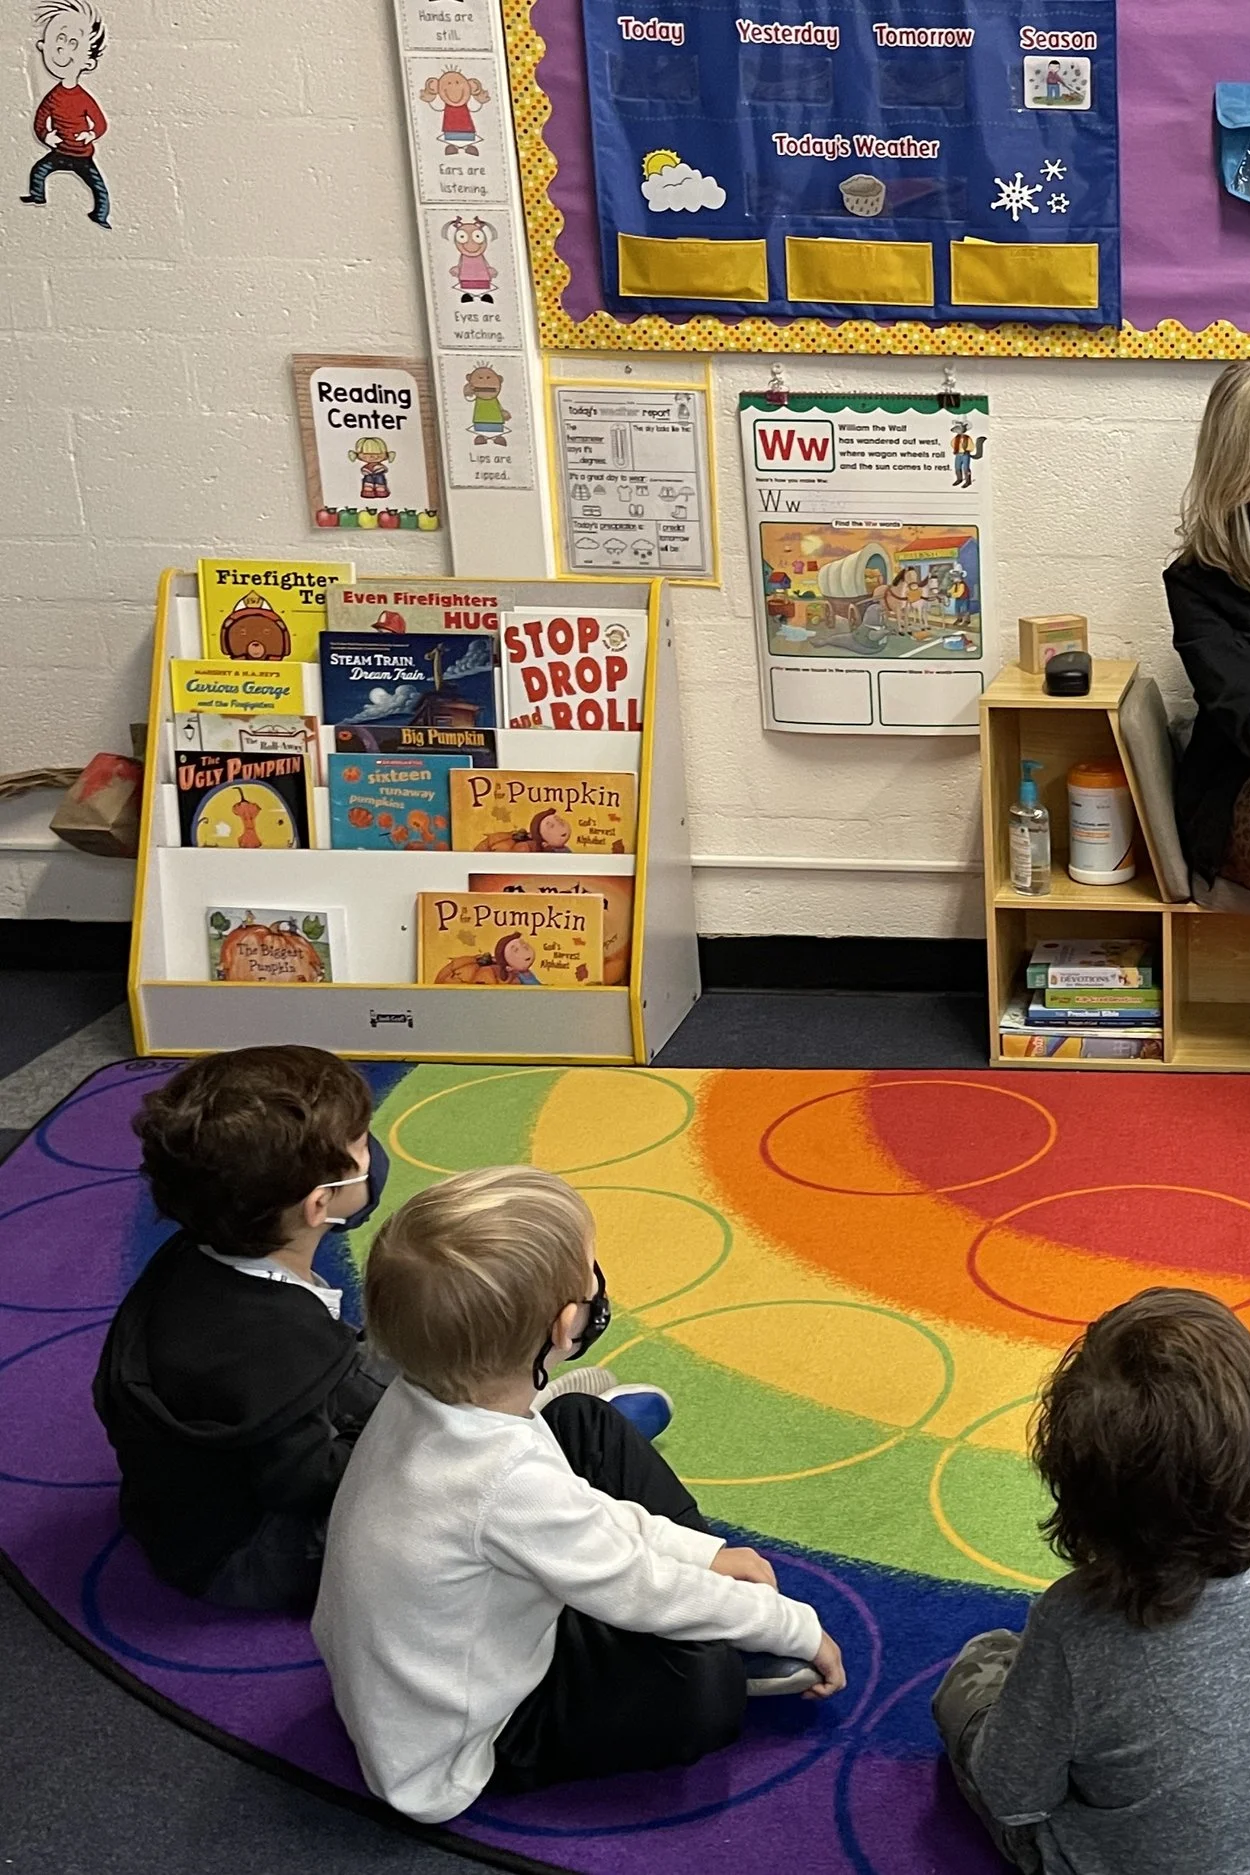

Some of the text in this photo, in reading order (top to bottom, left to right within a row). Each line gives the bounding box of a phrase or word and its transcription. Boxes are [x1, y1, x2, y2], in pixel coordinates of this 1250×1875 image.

[418, 10, 474, 22] Hands are
[618, 16, 1097, 51] Today Yesterday Tomorrow Season
[772, 132, 939, 160] Today's Weather
[439, 163, 486, 176] Ears are
[454, 310, 501, 324] Eyes are
[453, 328, 504, 343] watching.
[317, 381, 411, 409] Reading
[328, 408, 407, 430] Center
[642, 408, 671, 419] report
[838, 424, 907, 432] William the Wolf
[758, 428, 830, 462] Ww
[838, 437, 854, 445] has
[856, 437, 900, 445] wandered
[469, 452, 512, 464] Lips are
[868, 451, 897, 459] wagon
[216, 569, 339, 591] Firefighter
[300, 589, 326, 605] Te
[343, 591, 498, 608] Even Firefighters
[443, 612, 498, 631] HUG
[504, 617, 600, 663] STOP
[330, 653, 373, 666] STEAM
[349, 667, 425, 681] Dream Train
[520, 655, 628, 703] DROP
[186, 678, 290, 699] Curious George
[215, 700, 228, 708] the
[509, 698, 644, 731] and ROLL
[245, 737, 258, 745] The
[401, 728, 485, 748] Big Pumpkin
[201, 756, 221, 767] The
[178, 756, 301, 791] UGLY PUMPKIN
[367, 769, 432, 785] sixteen
[349, 794, 405, 809] pumpkins
[379, 787, 436, 802] runaway
[467, 776, 492, 808] P
[507, 781, 621, 812] Pumpkin
[578, 817, 597, 827] God's
[589, 828, 616, 837] Harvest
[576, 836, 606, 847] Alphabet
[434, 900, 458, 931] P
[473, 905, 586, 936] Pumpkin
[236, 942, 305, 960] The Biggest
[543, 941, 561, 951] God's
[553, 952, 580, 960] Harvest
[249, 959, 296, 976] Pumpkin
[540, 959, 570, 970] Alphabet
[1060, 975, 1110, 983] DEVOTIONS
